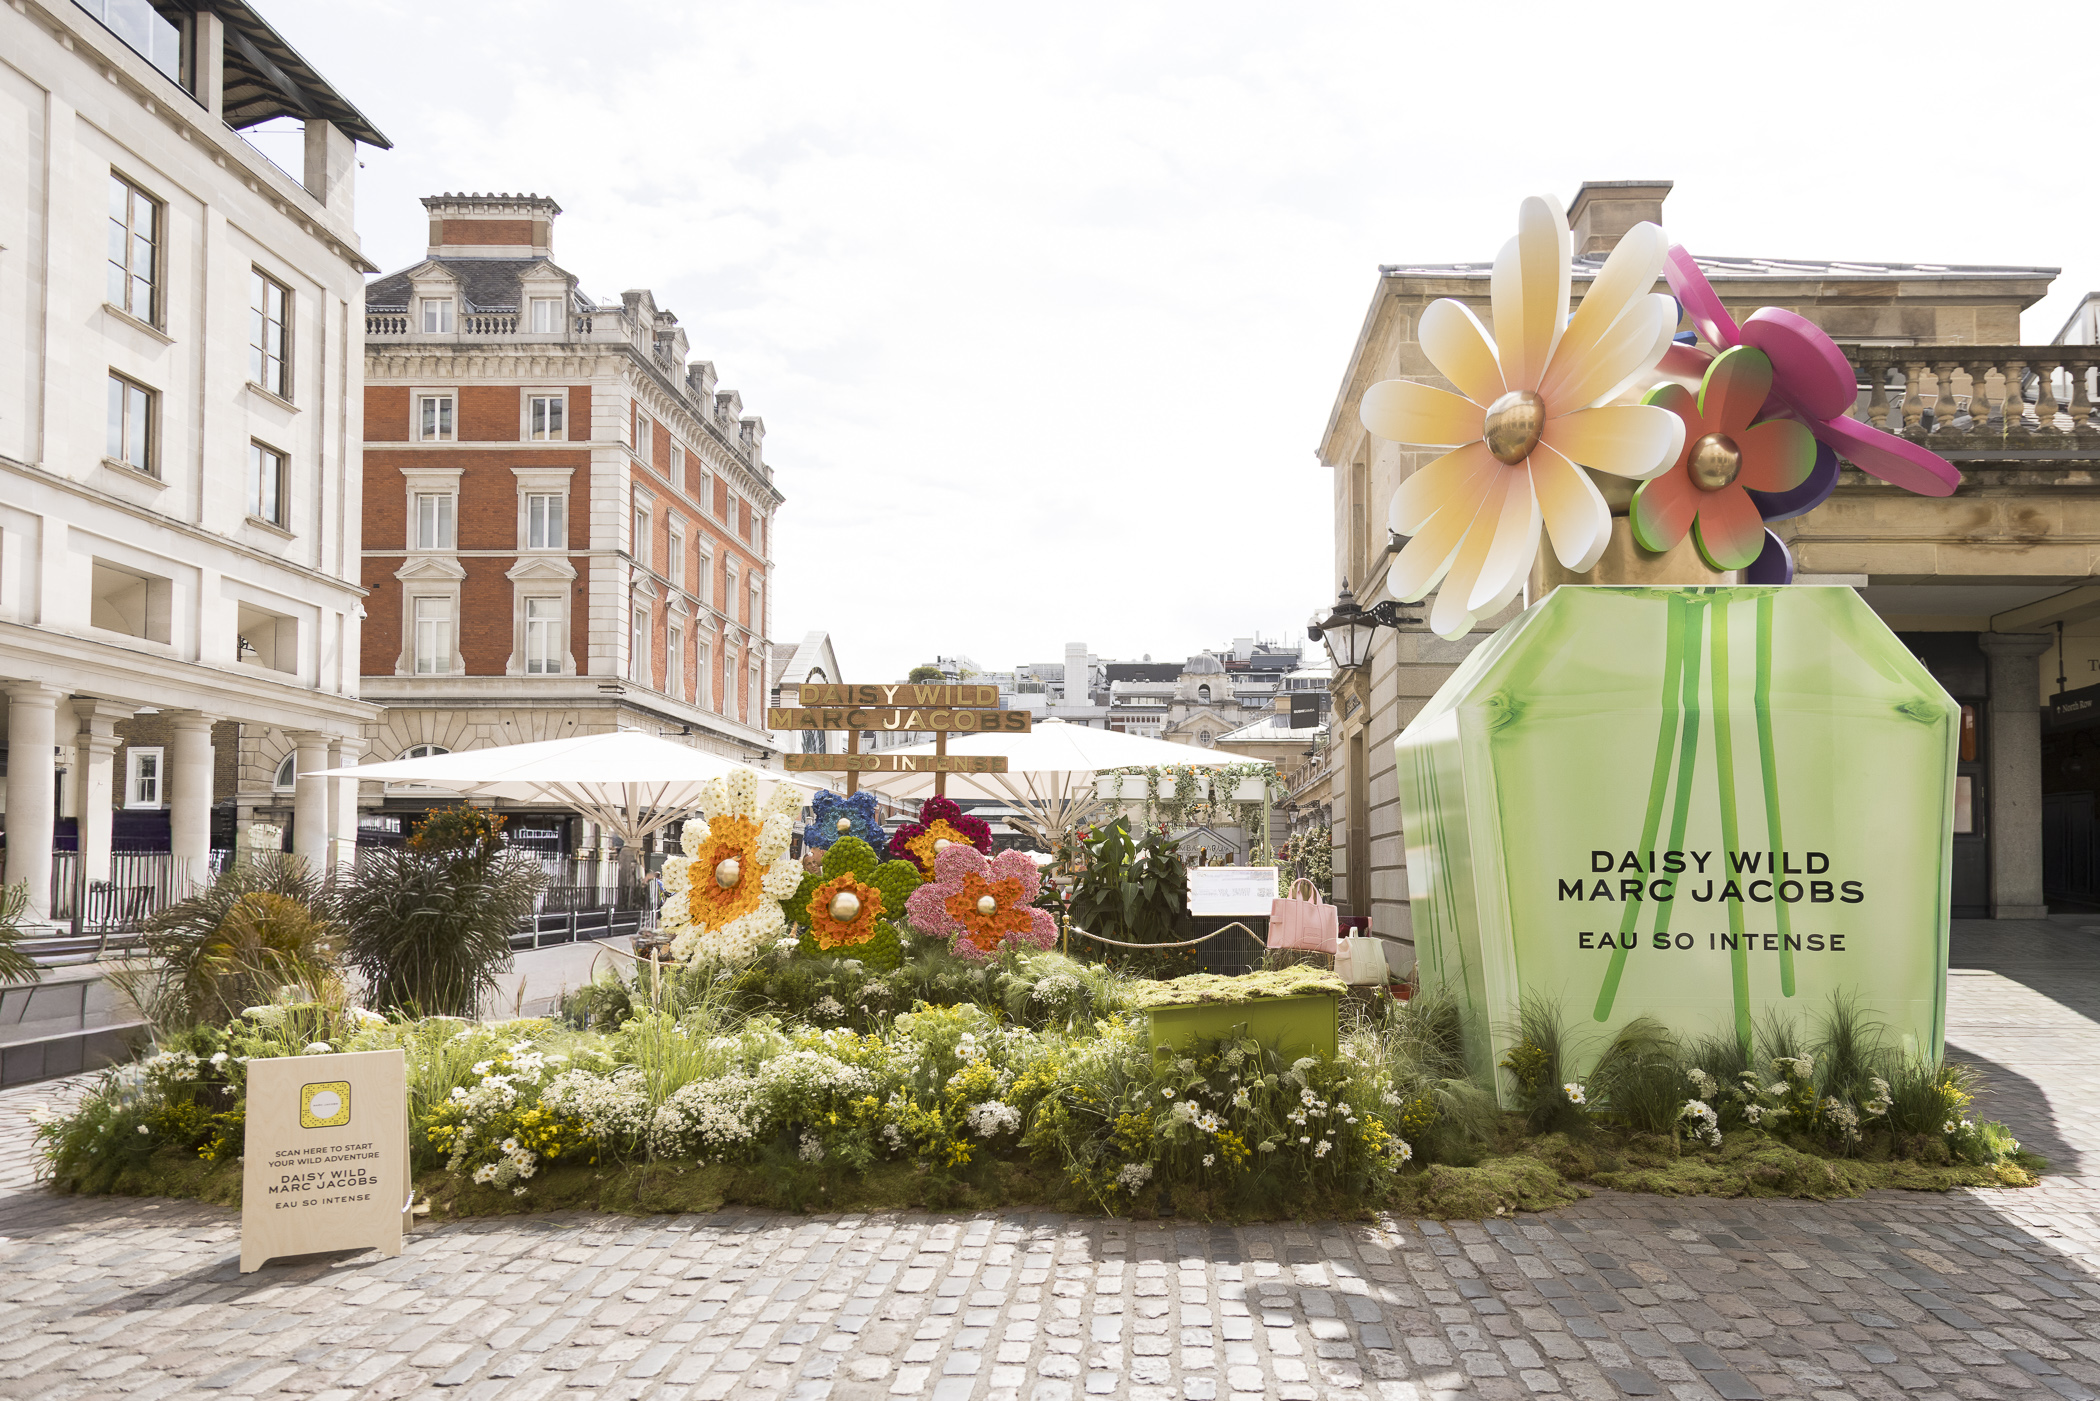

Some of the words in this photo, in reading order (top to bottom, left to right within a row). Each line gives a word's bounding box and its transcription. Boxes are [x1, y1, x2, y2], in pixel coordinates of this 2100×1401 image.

[800, 684, 899, 705] DAISY
[913, 685, 996, 705] WILD
[2062, 701, 2079, 713] North
[2079, 700, 2093, 710] Row
[771, 708, 867, 729] MARC
[882, 709, 1026, 731] JACOBS
[785, 754, 834, 770] EAU
[846, 755, 881, 770] SO
[892, 755, 1006, 772] INTENSE
[1591, 850, 1712, 873] DAISY
[1728, 851, 1830, 874] WILD
[1558, 878, 1675, 902] MARC
[1691, 879, 1864, 904] JACOBS
[1579, 931, 1638, 949] EAU
[1652, 932, 1694, 950] SO
[1710, 933, 1846, 952] INTENSE
[276, 1150, 300, 1158] SCAN
[303, 1147, 329, 1155] HERE
[330, 1145, 343, 1153] TO
[345, 1143, 373, 1152] START
[297, 1157, 322, 1165] WILD
[324, 1152, 380, 1162] ADVENTURE
[268, 1183, 311, 1194] MARC
[317, 1176, 378, 1190] JACOBS
[281, 1172, 325, 1184] DAISY
[331, 1168, 366, 1179] WILD
[276, 1201, 298, 1209] EAU
[302, 1199, 318, 1207] SO
[322, 1194, 370, 1204] INTENSE
